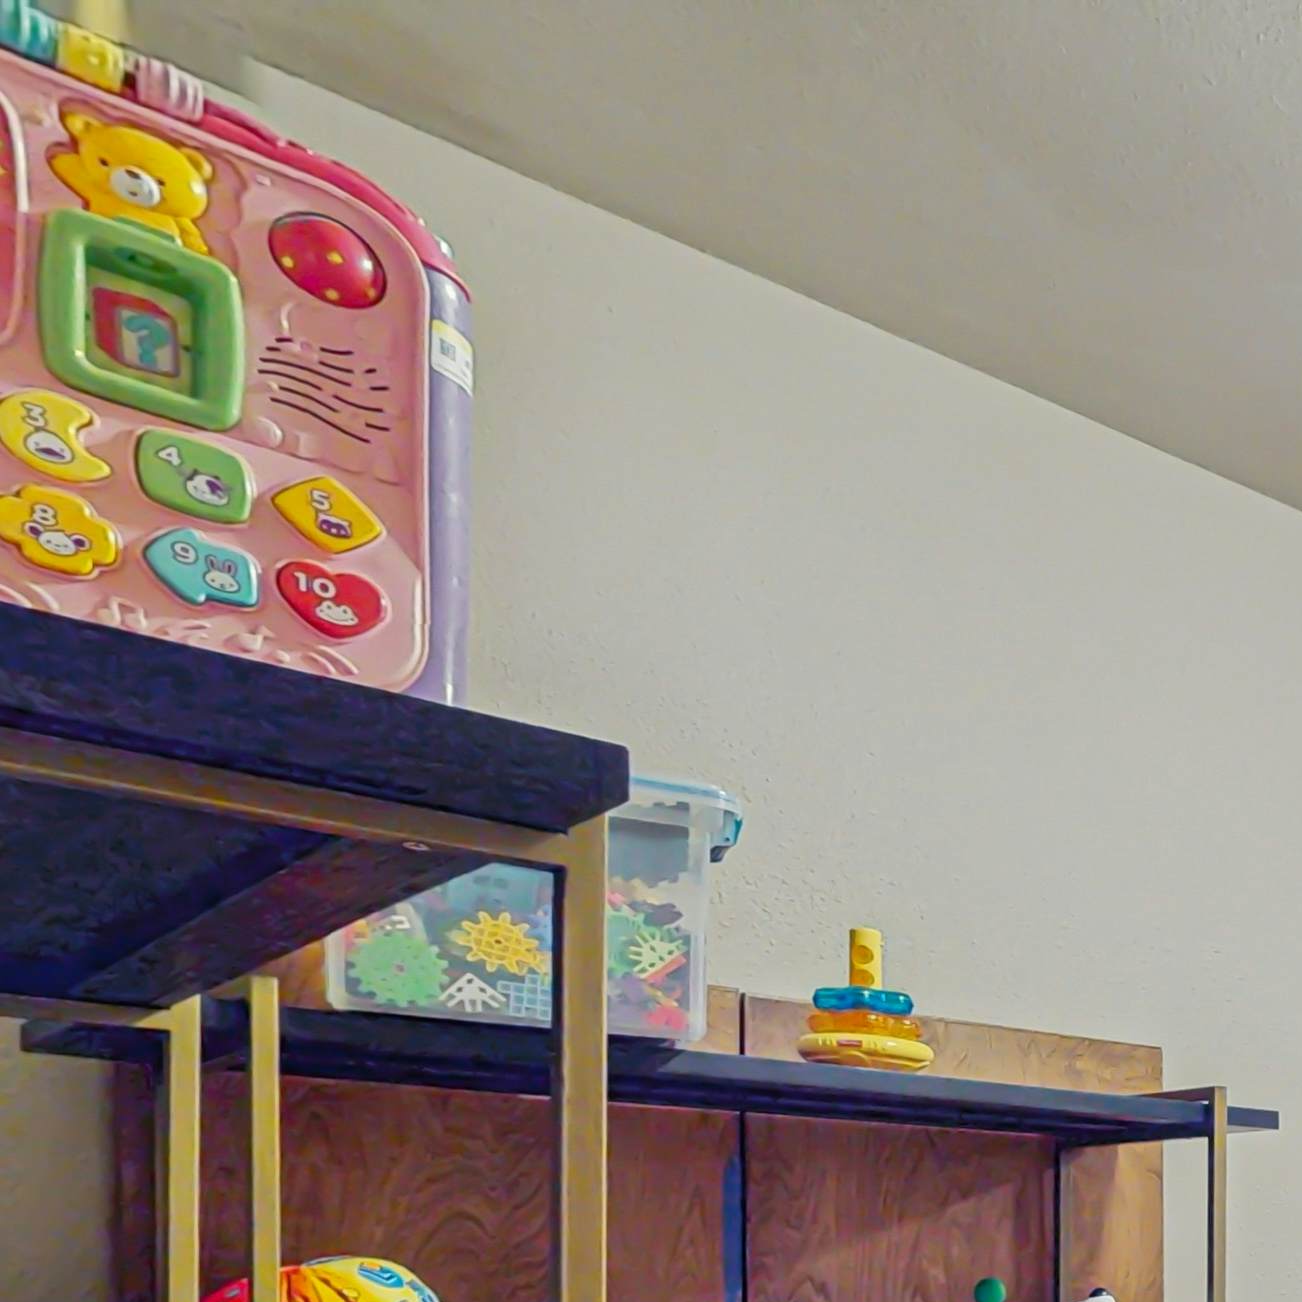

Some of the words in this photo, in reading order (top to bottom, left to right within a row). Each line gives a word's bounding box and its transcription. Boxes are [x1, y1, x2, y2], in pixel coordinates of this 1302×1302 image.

[310, 489, 331, 511] 5
[171, 541, 198, 565] 9
[294, 570, 337, 600] 10
